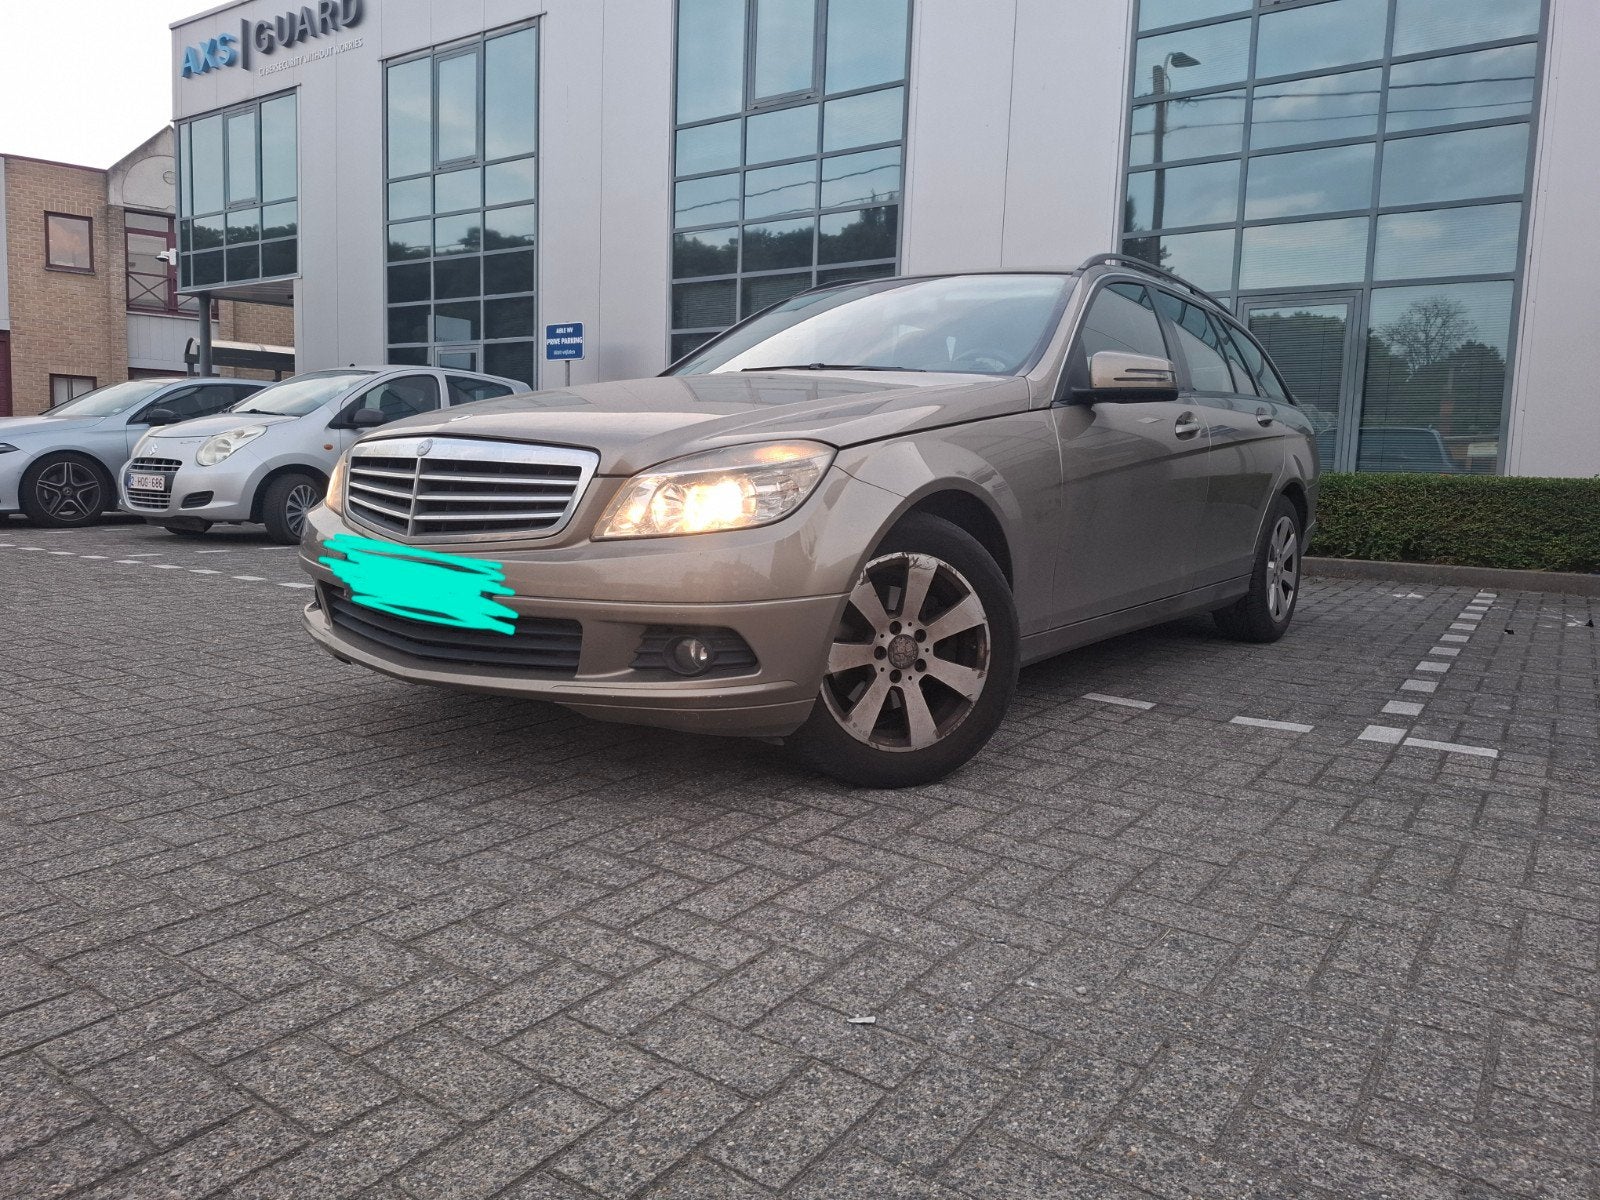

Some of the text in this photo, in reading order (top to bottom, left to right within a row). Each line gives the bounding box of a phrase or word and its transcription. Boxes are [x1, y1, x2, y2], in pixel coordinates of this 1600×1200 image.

[182, 0, 363, 78] AXS GUARD
[258, 37, 364, 77] CYBERSECURITY WITHOUT WORRIES
[561, 336, 583, 344] PARKING
